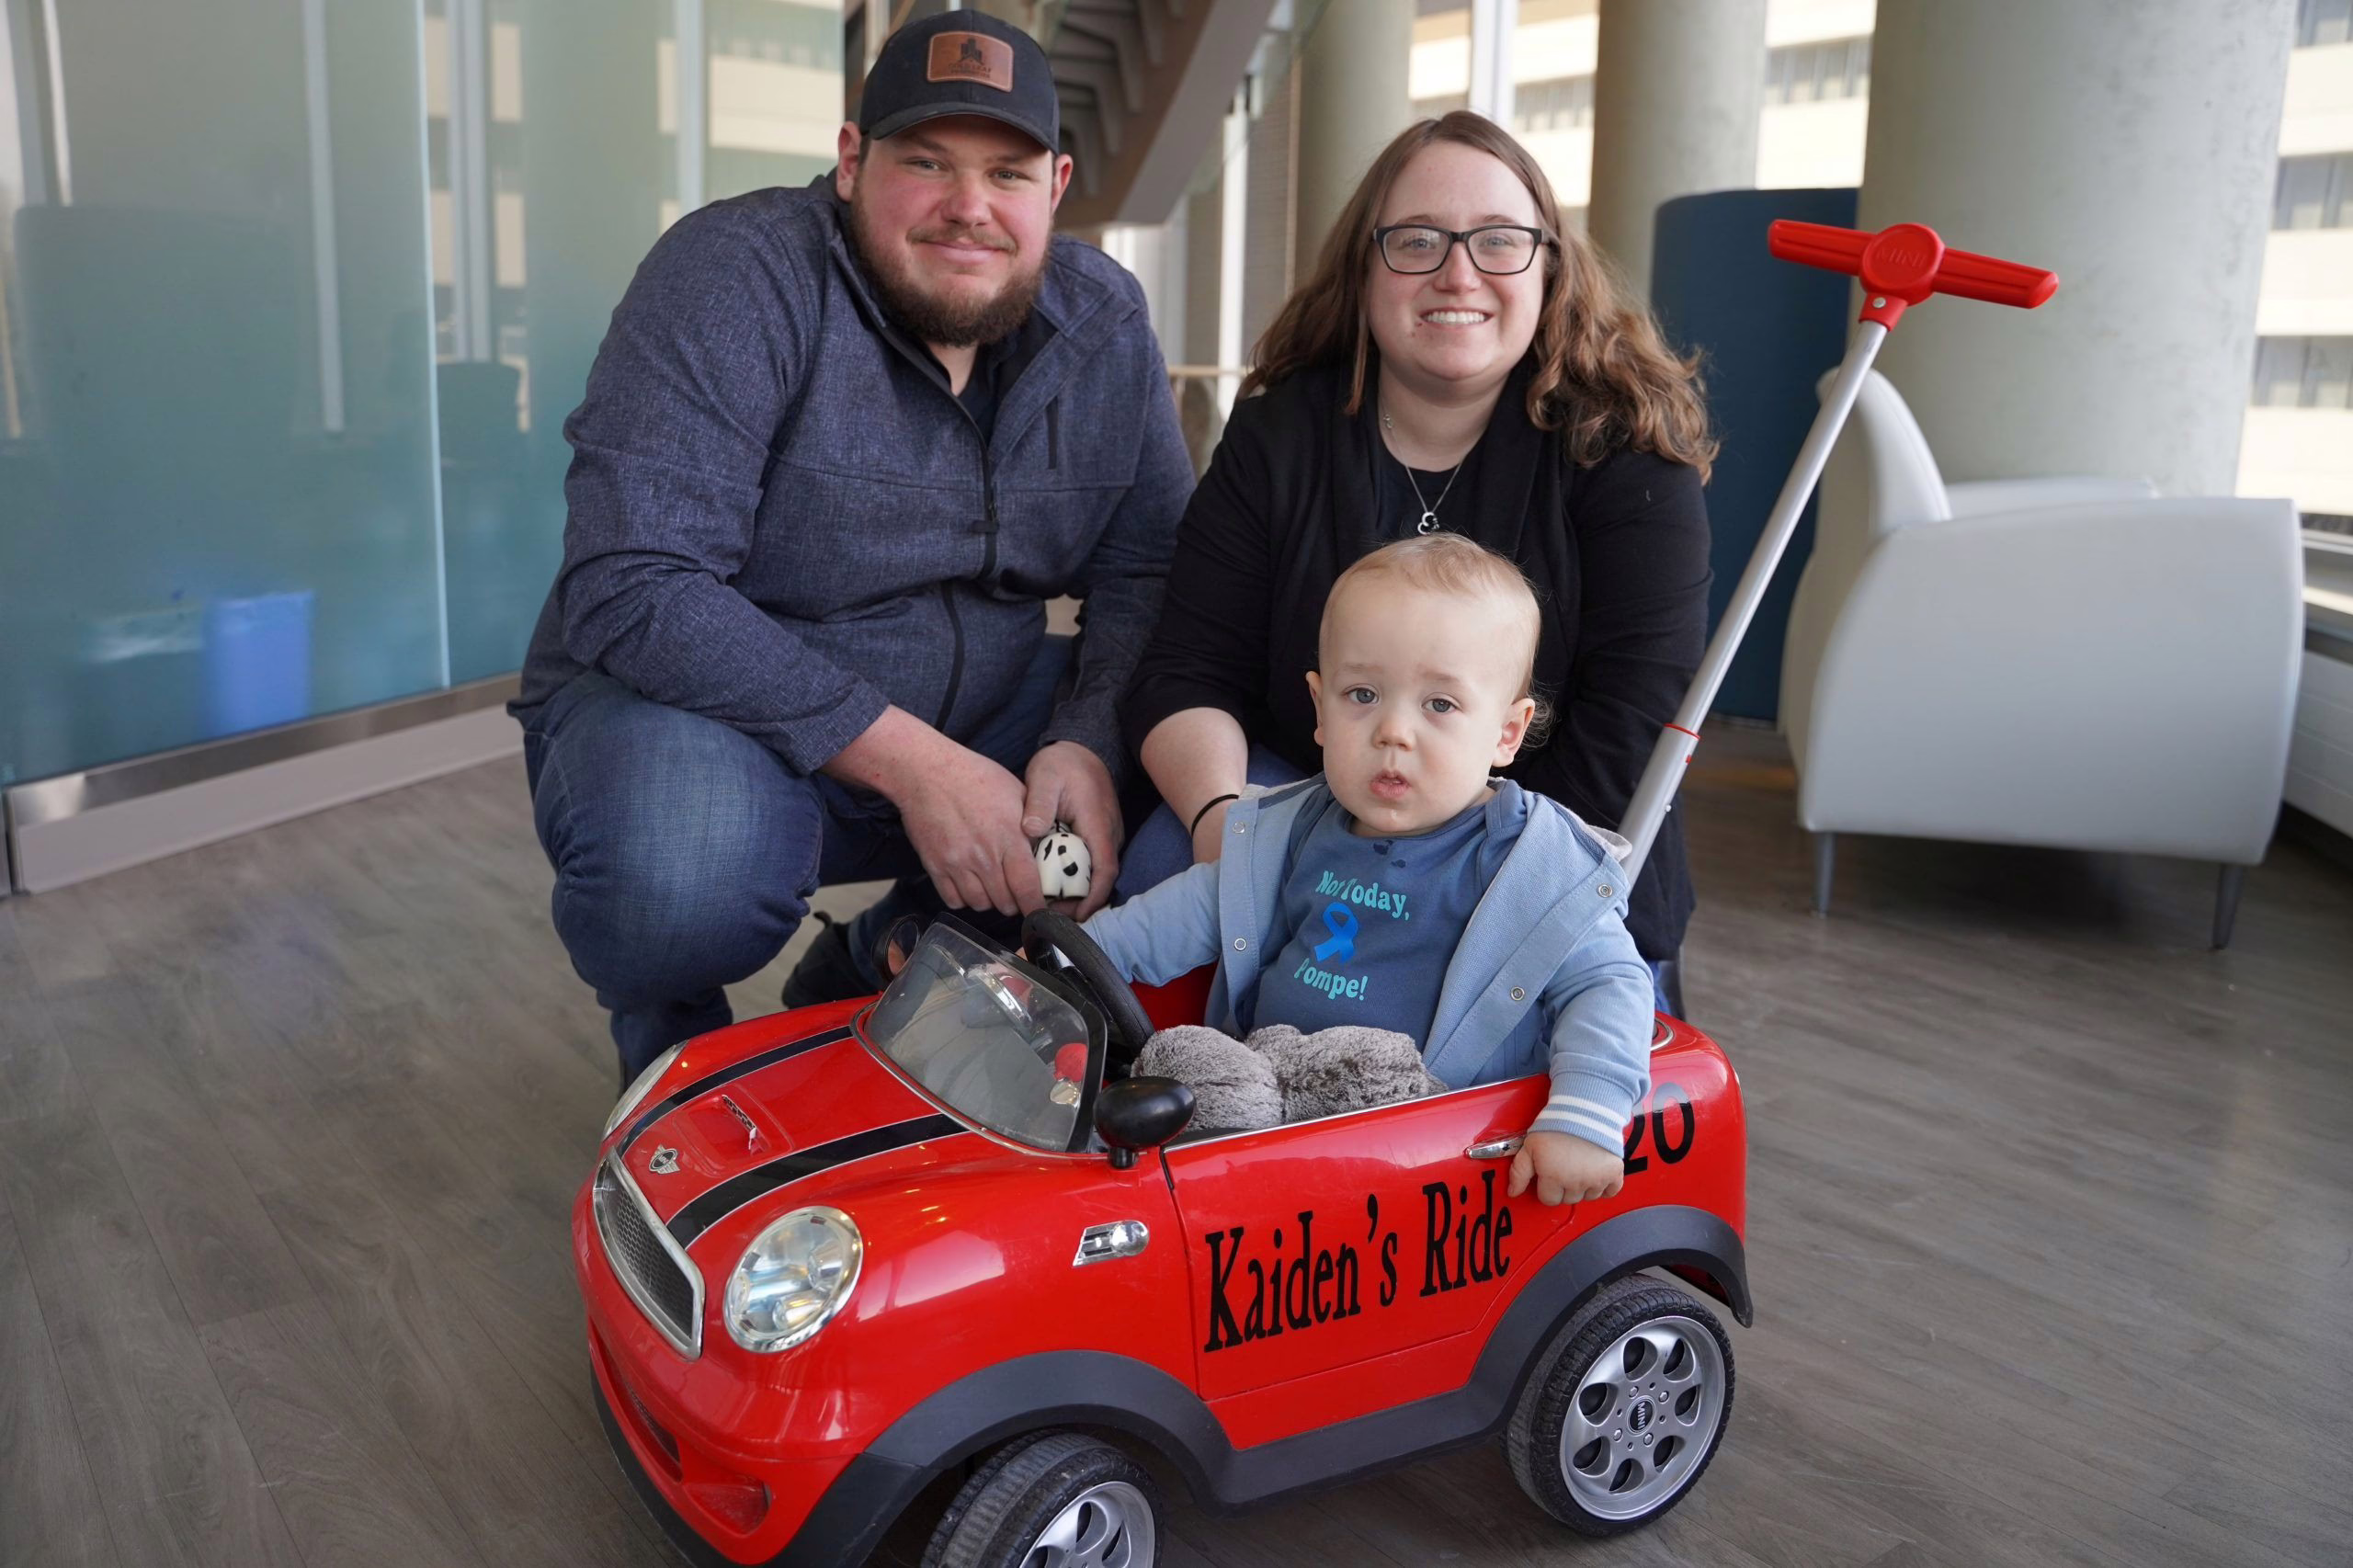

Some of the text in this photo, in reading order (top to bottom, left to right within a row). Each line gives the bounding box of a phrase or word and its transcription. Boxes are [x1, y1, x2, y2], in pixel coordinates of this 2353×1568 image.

[1315, 870, 1410, 921] Not Today,
[1293, 957, 1369, 1001] Pompe!
[1202, 1168, 1512, 1353] Kaiden's Ride
[1637, 1402, 1645, 1430] MINI
